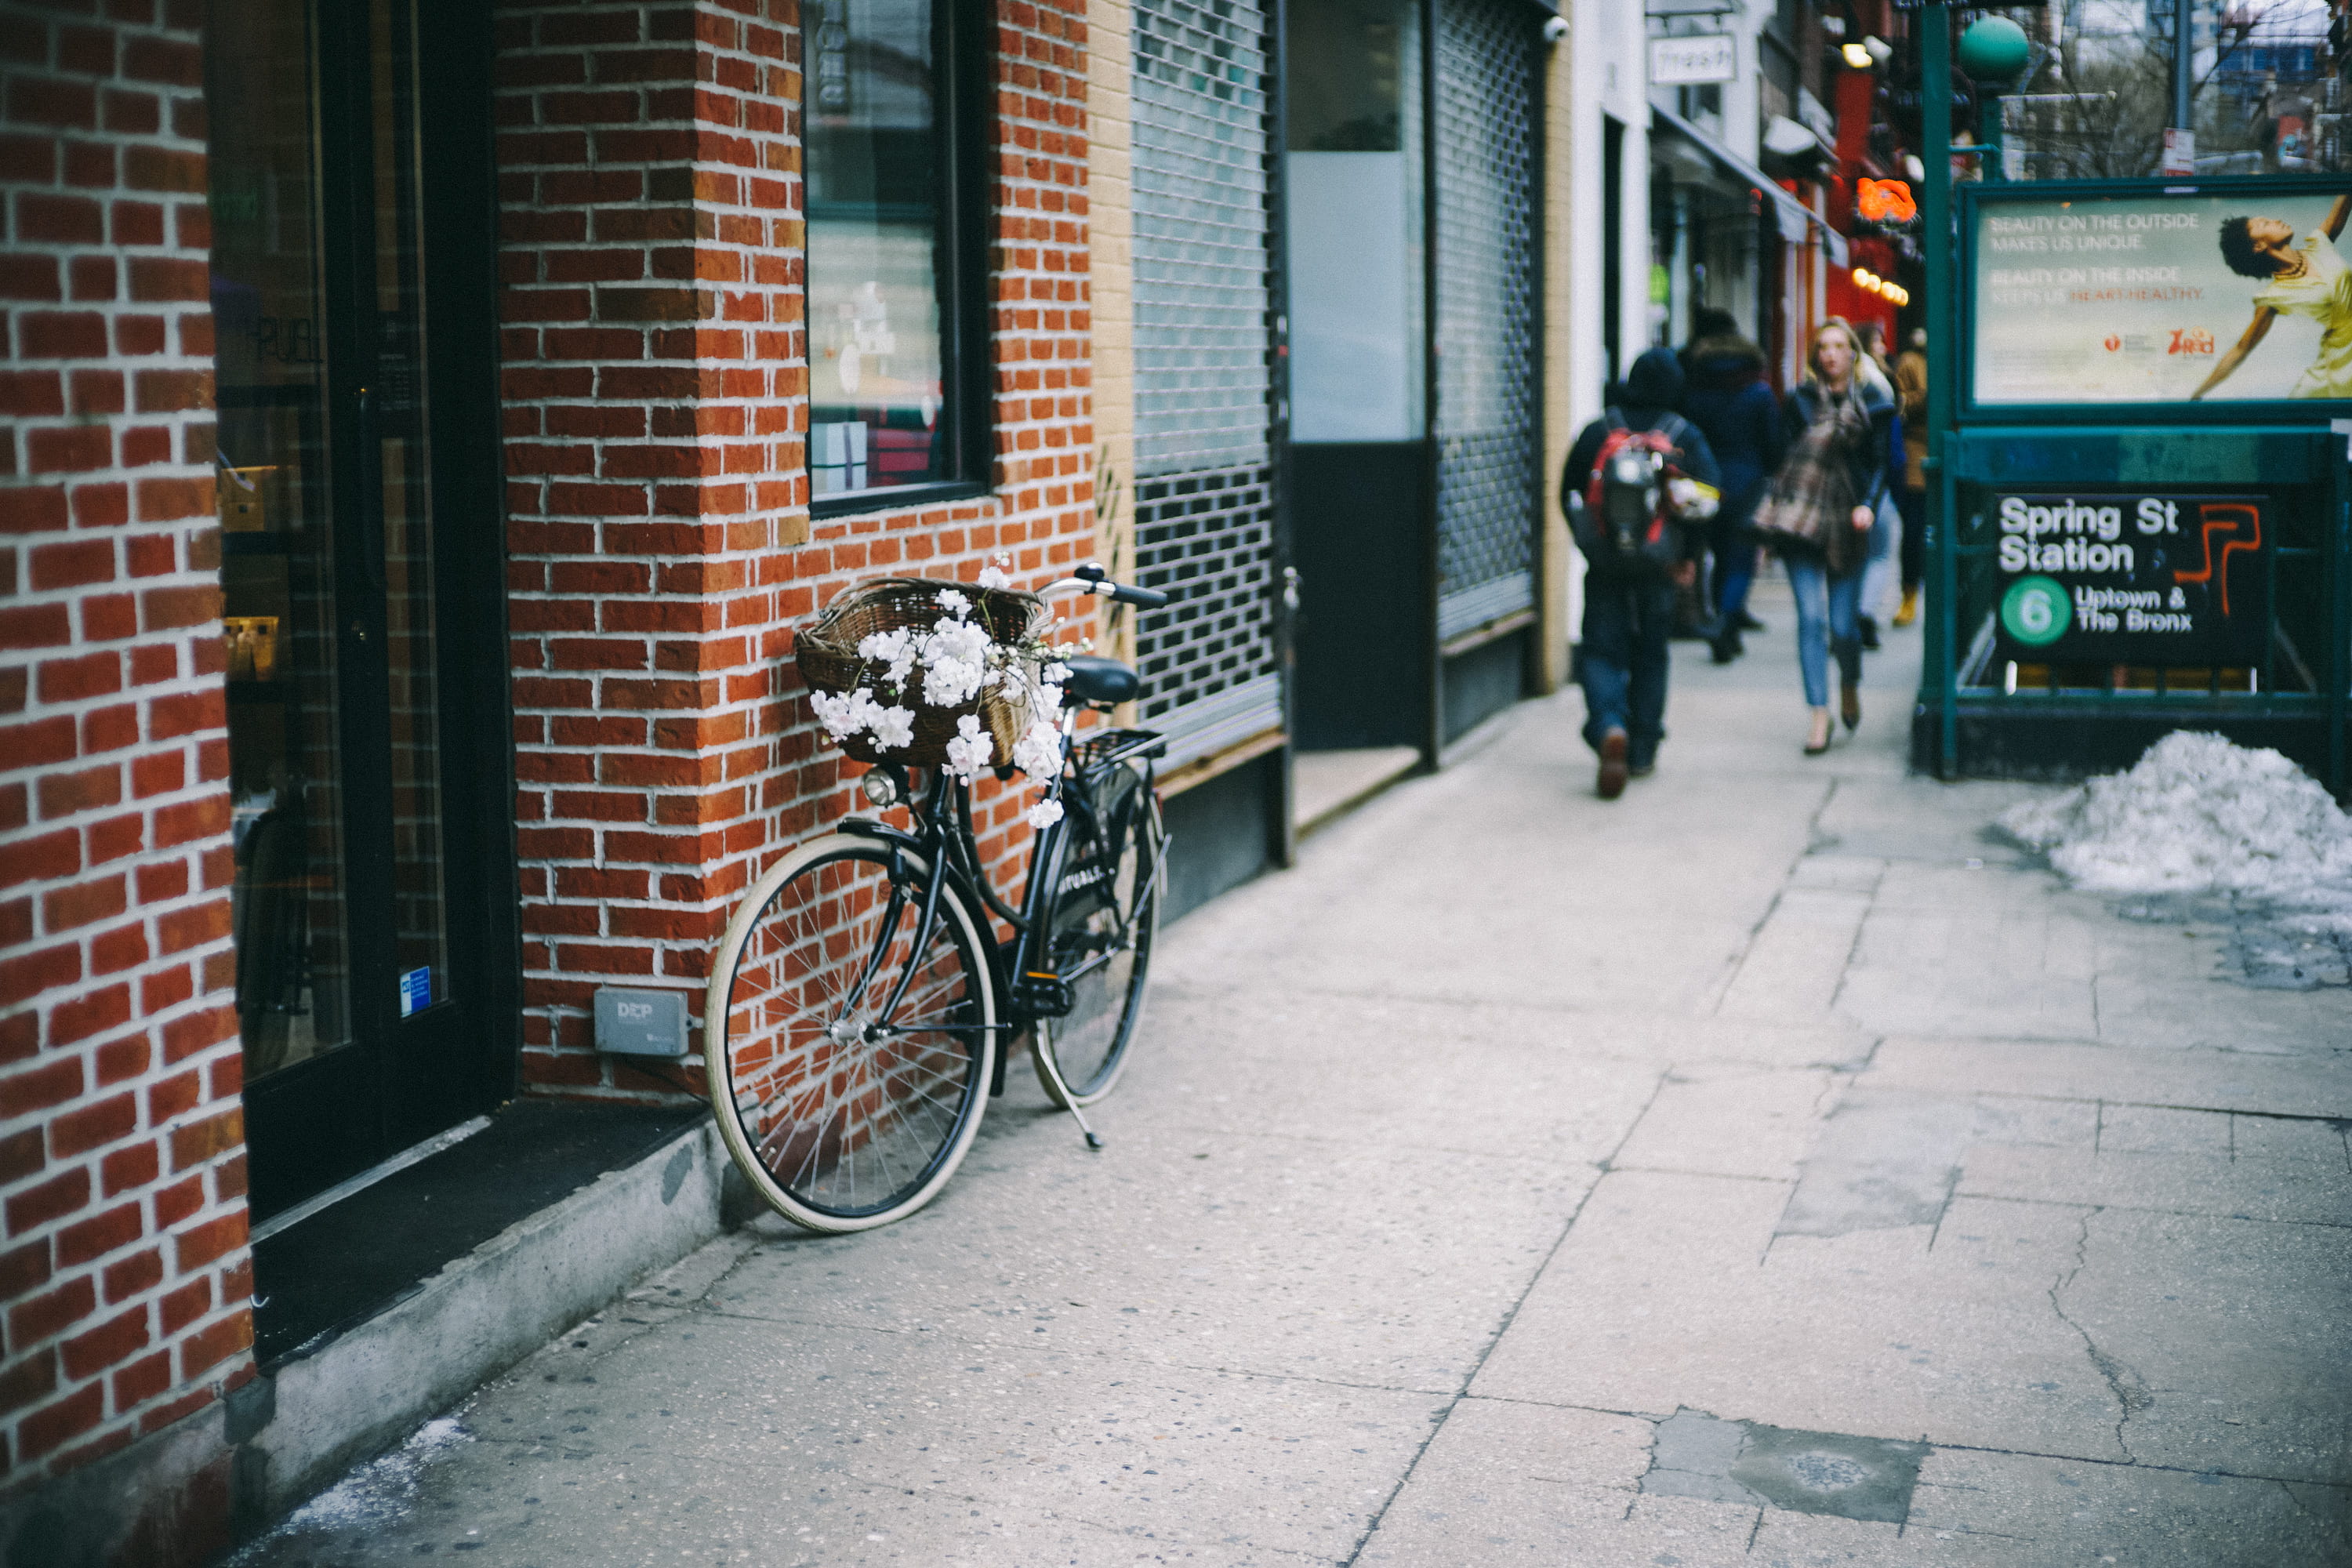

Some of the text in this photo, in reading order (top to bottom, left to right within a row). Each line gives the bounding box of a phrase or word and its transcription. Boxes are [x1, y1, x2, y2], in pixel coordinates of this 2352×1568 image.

[1991, 213, 2200, 233] BEAUTY ON THE OUTSIDE
[1992, 236, 2049, 252] MAKES
[2053, 235, 2074, 250] US
[1991, 267, 2181, 286] BEAUTY ON THE INSIDE
[2045, 289, 2067, 303] US
[1999, 496, 2179, 541] Spring St
[1998, 534, 2134, 572] Station
[2074, 586, 2187, 609] Uptown &
[2020, 590, 2053, 633] 6
[2076, 608, 2193, 633] The Bronx
